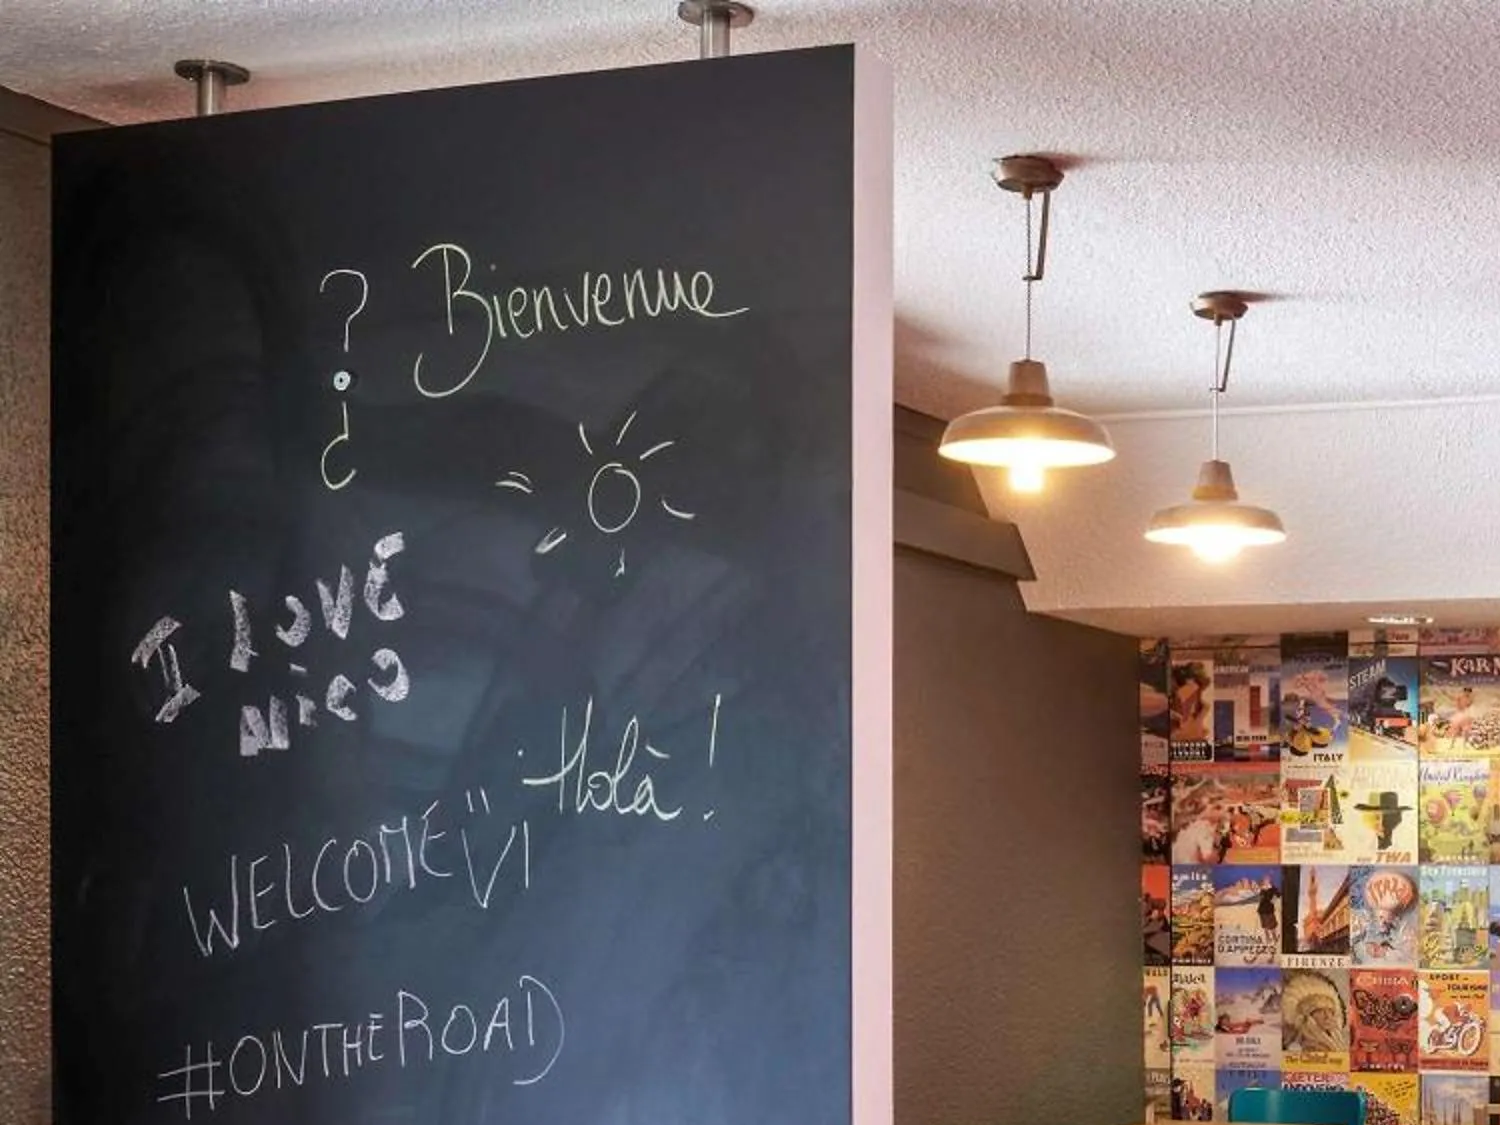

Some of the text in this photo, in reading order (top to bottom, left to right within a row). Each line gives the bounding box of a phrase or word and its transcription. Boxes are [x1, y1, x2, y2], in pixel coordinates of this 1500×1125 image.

[412, 243, 750, 398] Bienvenue
[1349, 658, 1387, 690] STEAM
[1313, 753, 1344, 763] ITALY
[1375, 851, 1412, 864] TWA
[183, 800, 453, 957] WELCOME
[1287, 957, 1345, 968] FIRENZE
[158, 975, 566, 1121] #ONTHEROAD
